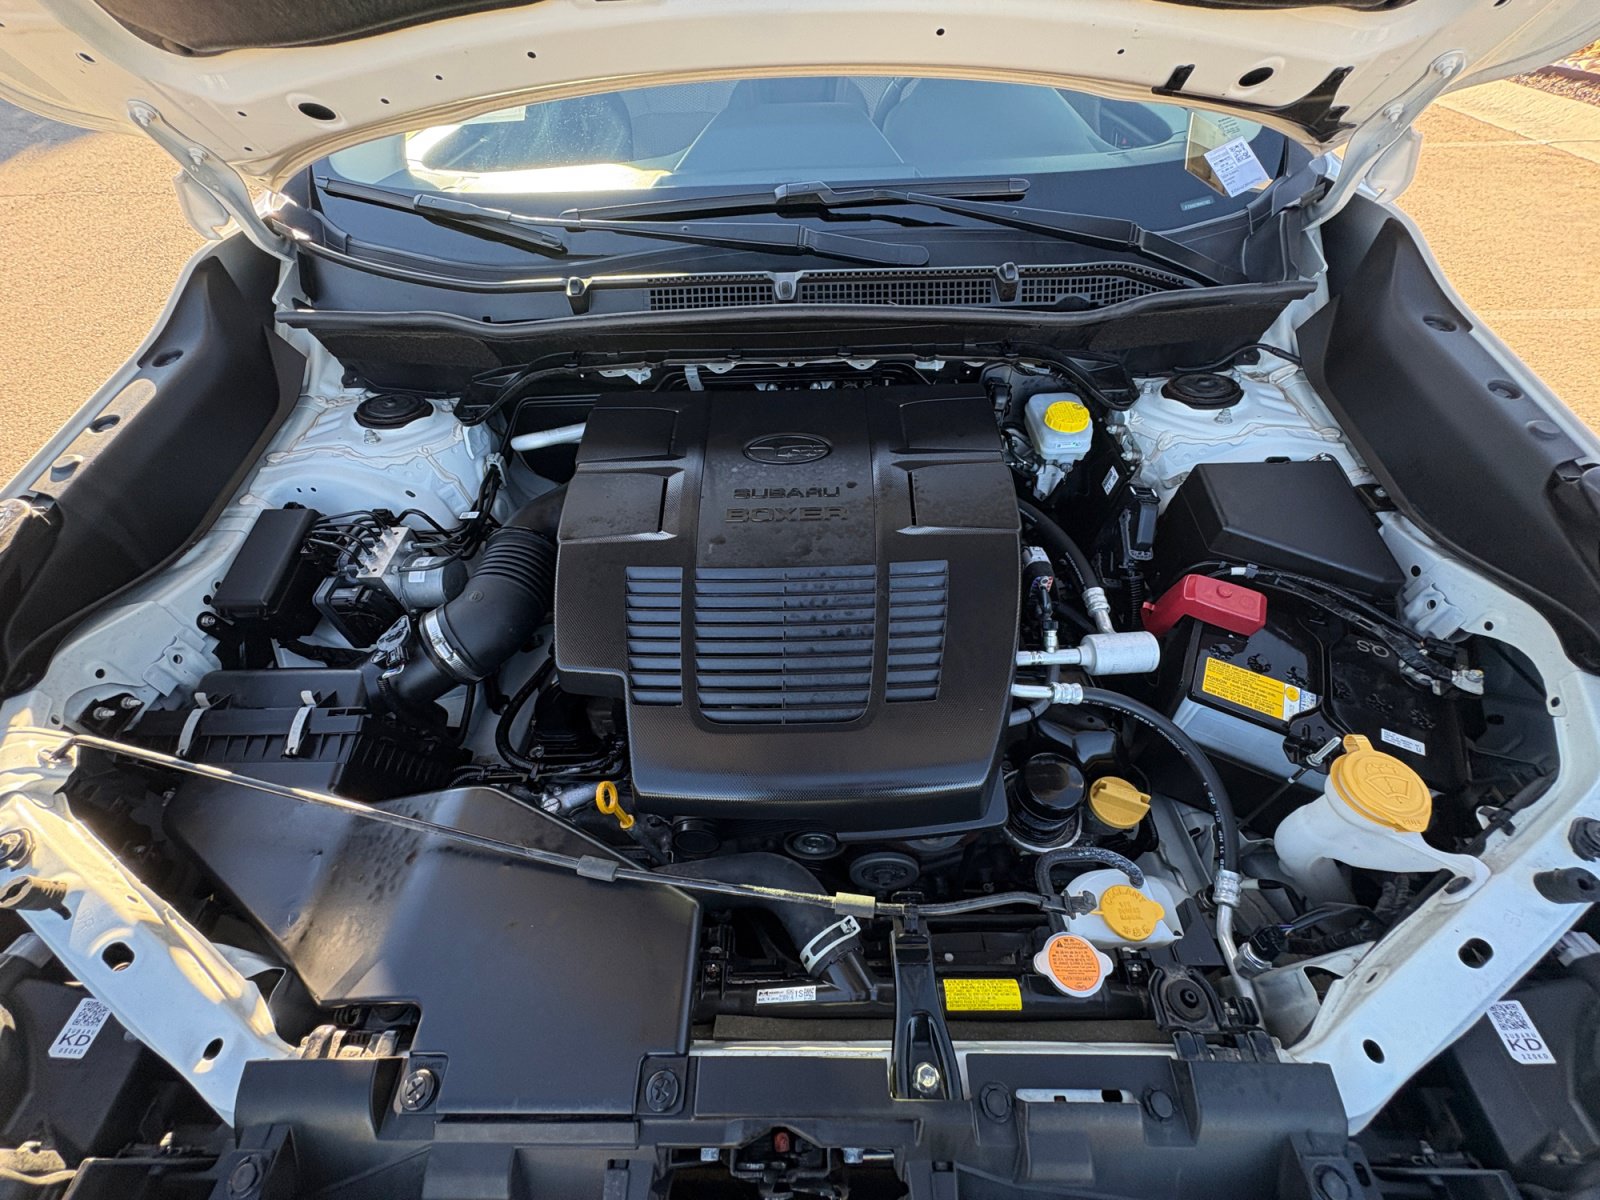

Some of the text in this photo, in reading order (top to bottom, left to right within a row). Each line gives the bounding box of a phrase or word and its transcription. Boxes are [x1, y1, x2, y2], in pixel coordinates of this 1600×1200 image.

[734, 487, 840, 499] SUBARU
[725, 507, 848, 523] BOXER
[58, 1032, 92, 1047] KD
[1507, 1038, 1543, 1052] KD
